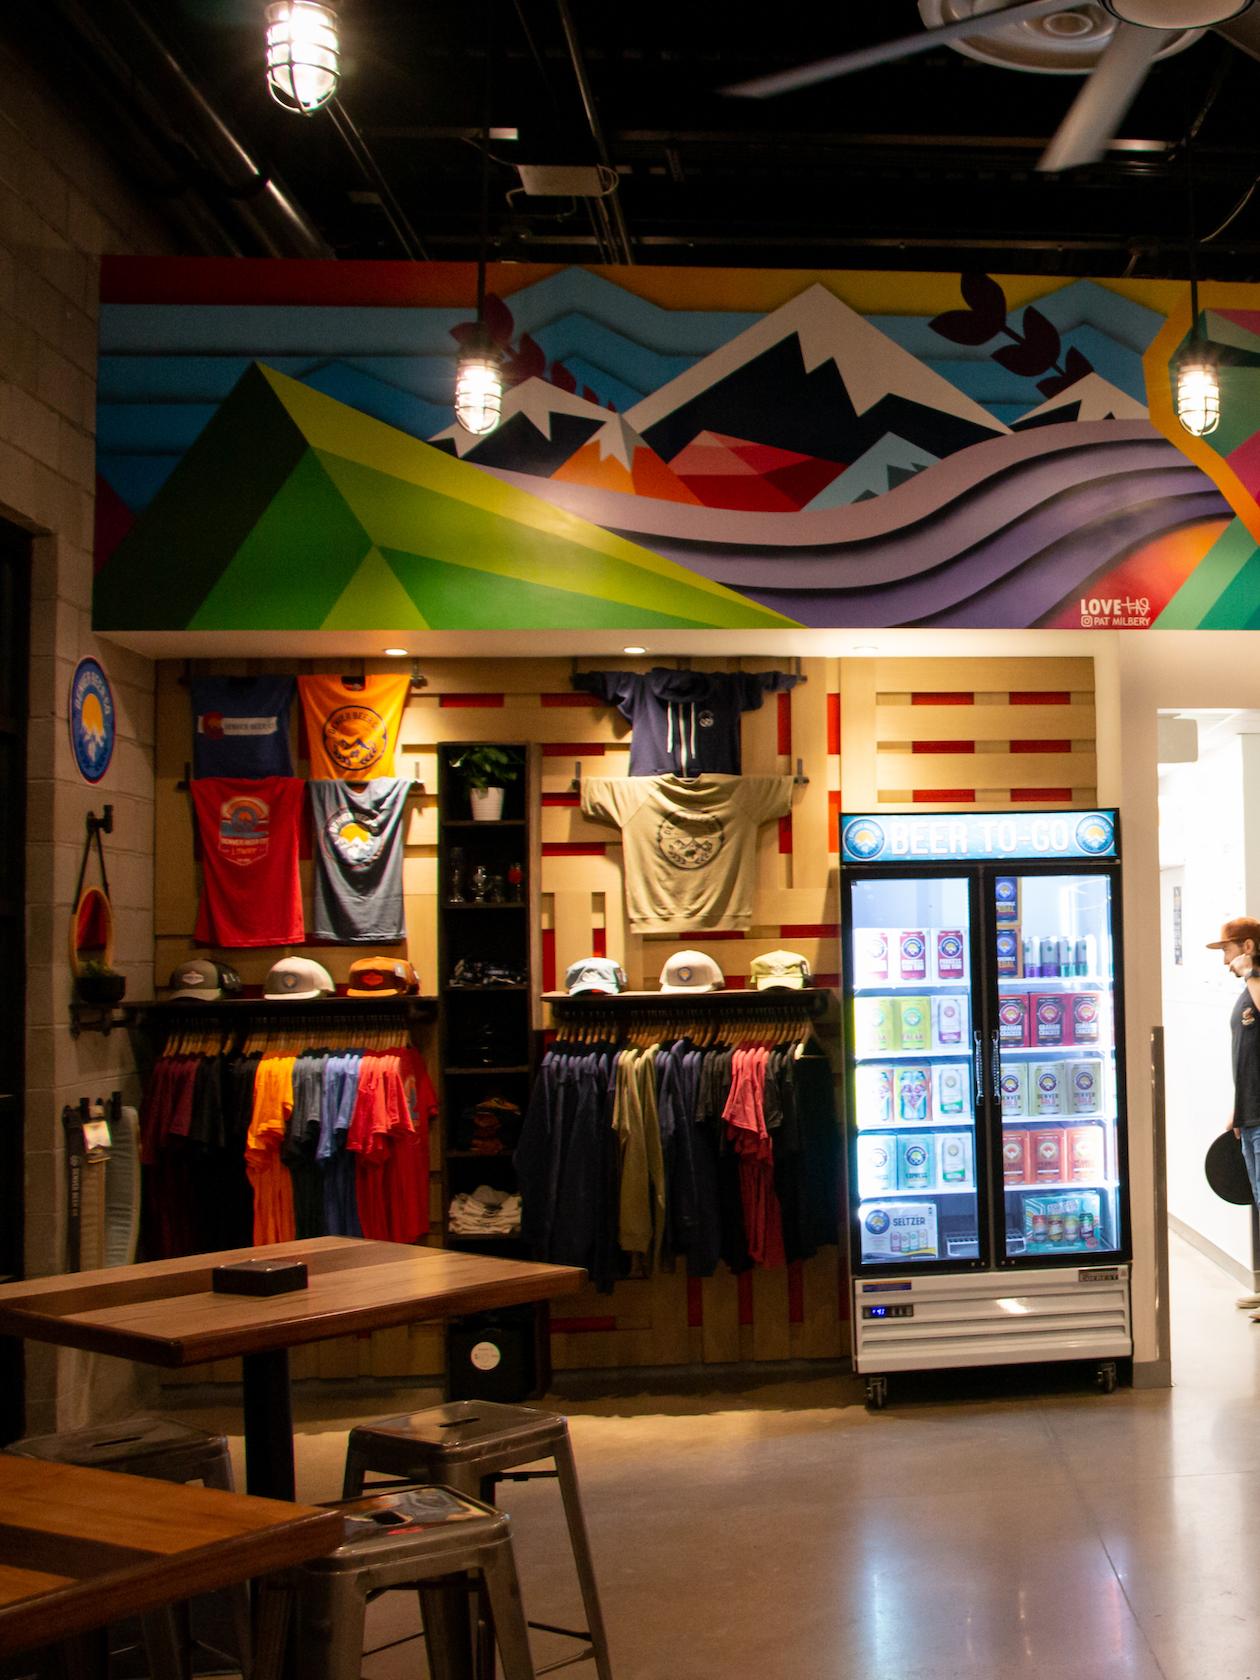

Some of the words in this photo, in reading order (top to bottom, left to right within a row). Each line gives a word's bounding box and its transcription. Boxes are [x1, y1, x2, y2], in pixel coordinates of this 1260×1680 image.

[1080, 598, 1122, 616] LOVE
[1094, 616, 1110, 626] PAT
[1112, 616, 1151, 627] MILBERY
[328, 712, 351, 734] DENVER
[890, 821, 968, 856] BEER
[978, 819, 1070, 853] TO-GO
[893, 1217, 926, 1227] SELTZER
